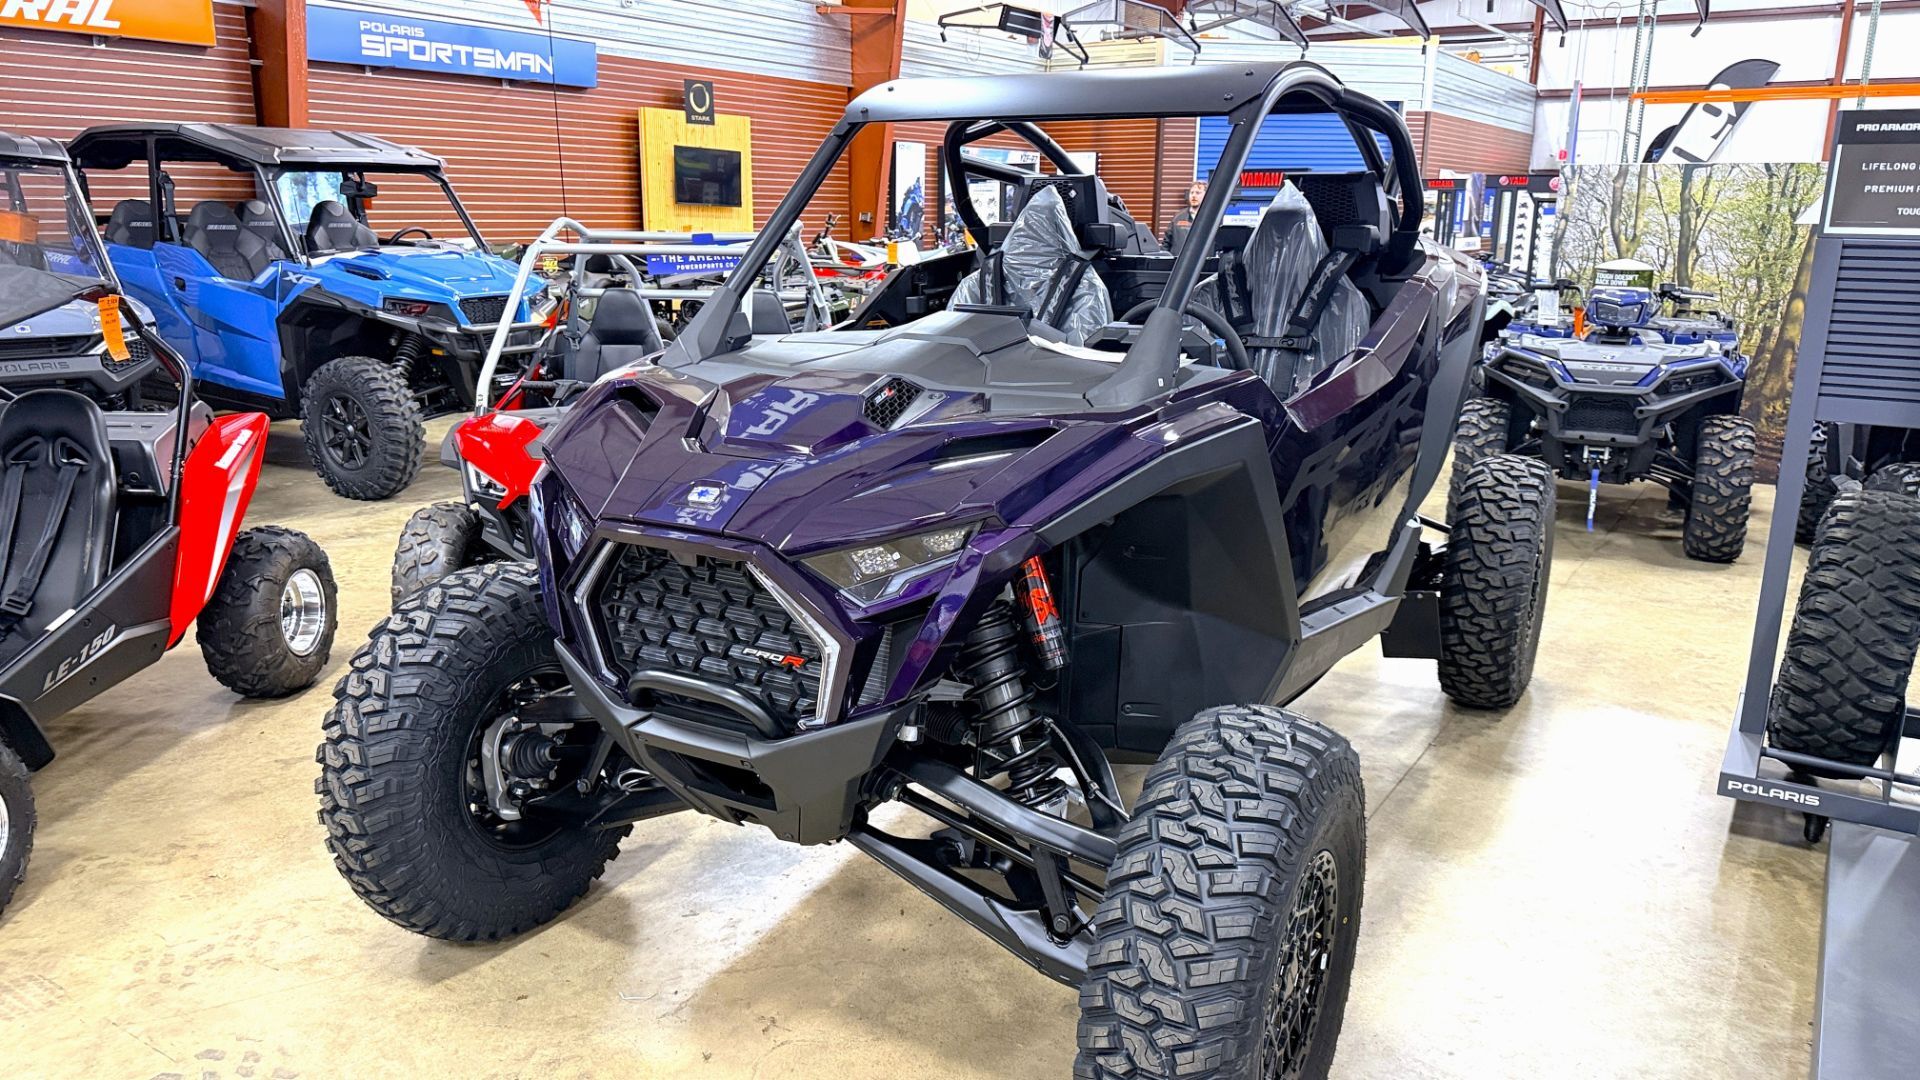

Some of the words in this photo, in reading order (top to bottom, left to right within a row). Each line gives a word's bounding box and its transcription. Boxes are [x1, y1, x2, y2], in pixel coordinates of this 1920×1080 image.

[360, 21, 425, 38] POLARIS
[361, 34, 553, 75] SPORTSMAN
[1862, 162, 1917, 171] LIFELONG
[1864, 185, 1914, 193] PREMIUM
[661, 255, 684, 263] THE
[676, 261, 723, 270] POWERSPORTS
[282, 271, 322, 285] XP
[42, 623, 116, 692] LE-150
[1727, 780, 1820, 806] POLARIS
